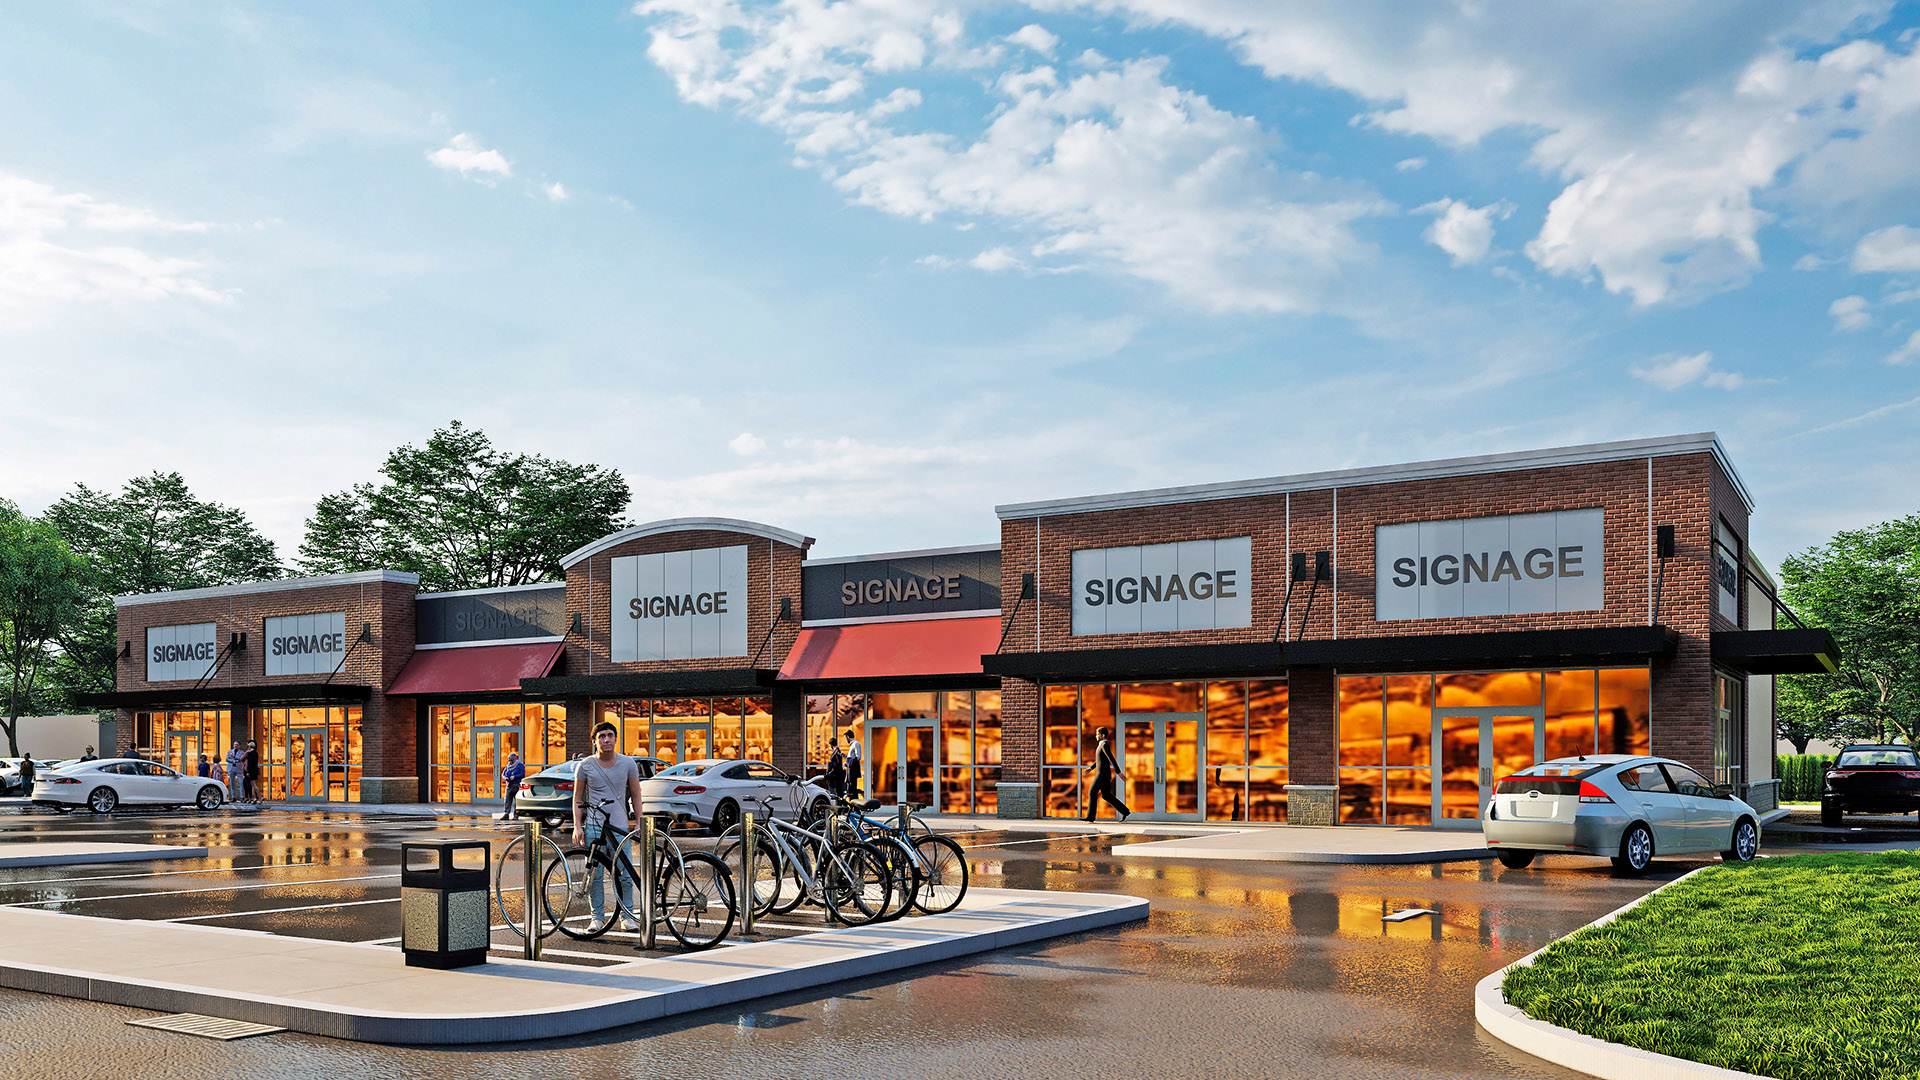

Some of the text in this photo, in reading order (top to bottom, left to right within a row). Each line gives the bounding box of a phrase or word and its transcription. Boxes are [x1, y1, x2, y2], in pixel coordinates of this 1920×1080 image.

[1392, 545, 1585, 588] SIGNAGE
[841, 573, 961, 606] SIGNAGE
[1085, 569, 1237, 607] SIGNAGE
[455, 605, 539, 631] SIGNAGE
[629, 591, 727, 619] SIGNAGE
[153, 642, 214, 663] SIGNAGE
[272, 633, 343, 656] SIGNAGE
